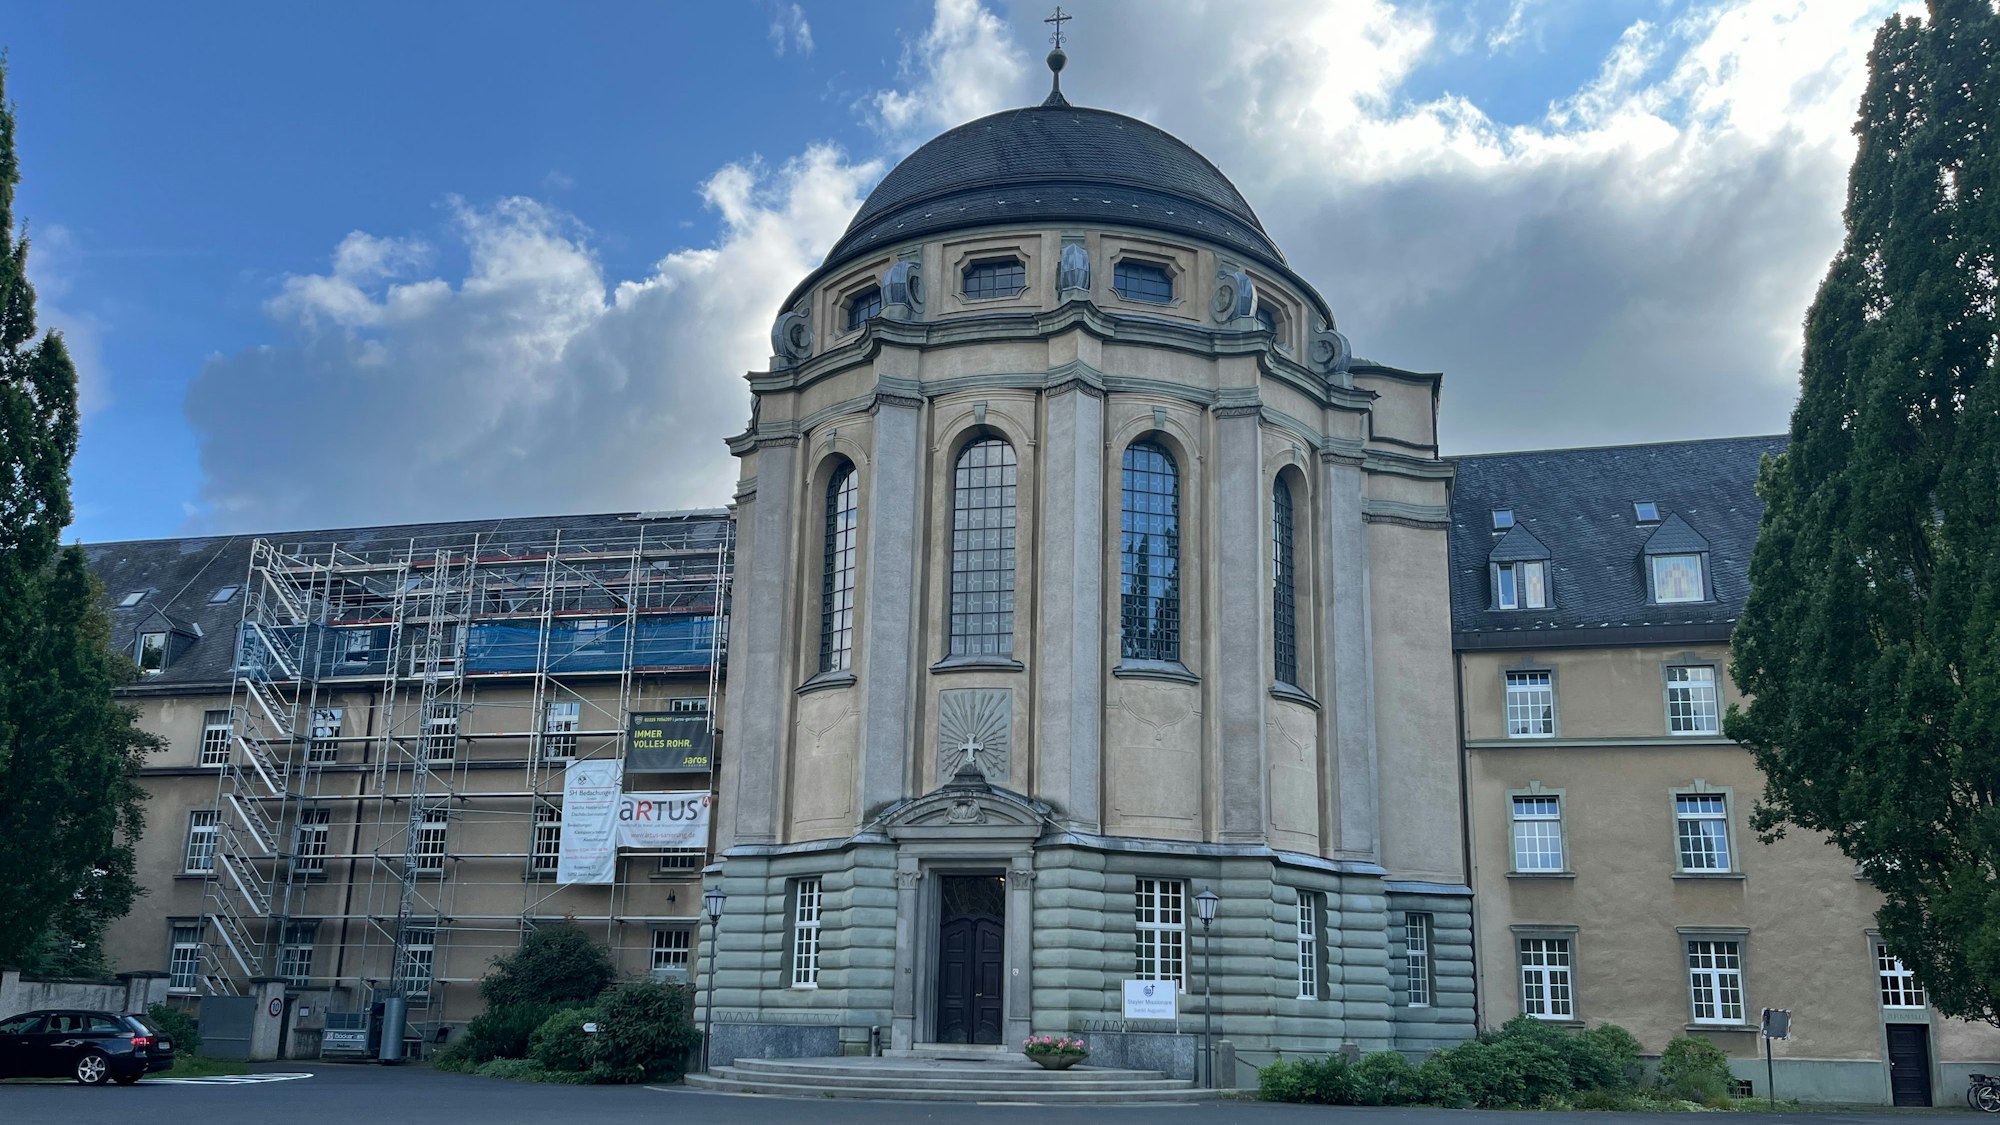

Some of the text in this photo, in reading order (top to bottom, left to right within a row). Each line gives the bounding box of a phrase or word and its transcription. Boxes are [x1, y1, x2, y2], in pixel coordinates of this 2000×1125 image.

[634, 730, 662, 738] IMMER
[633, 739, 693, 748] VOLLES ROHR.
